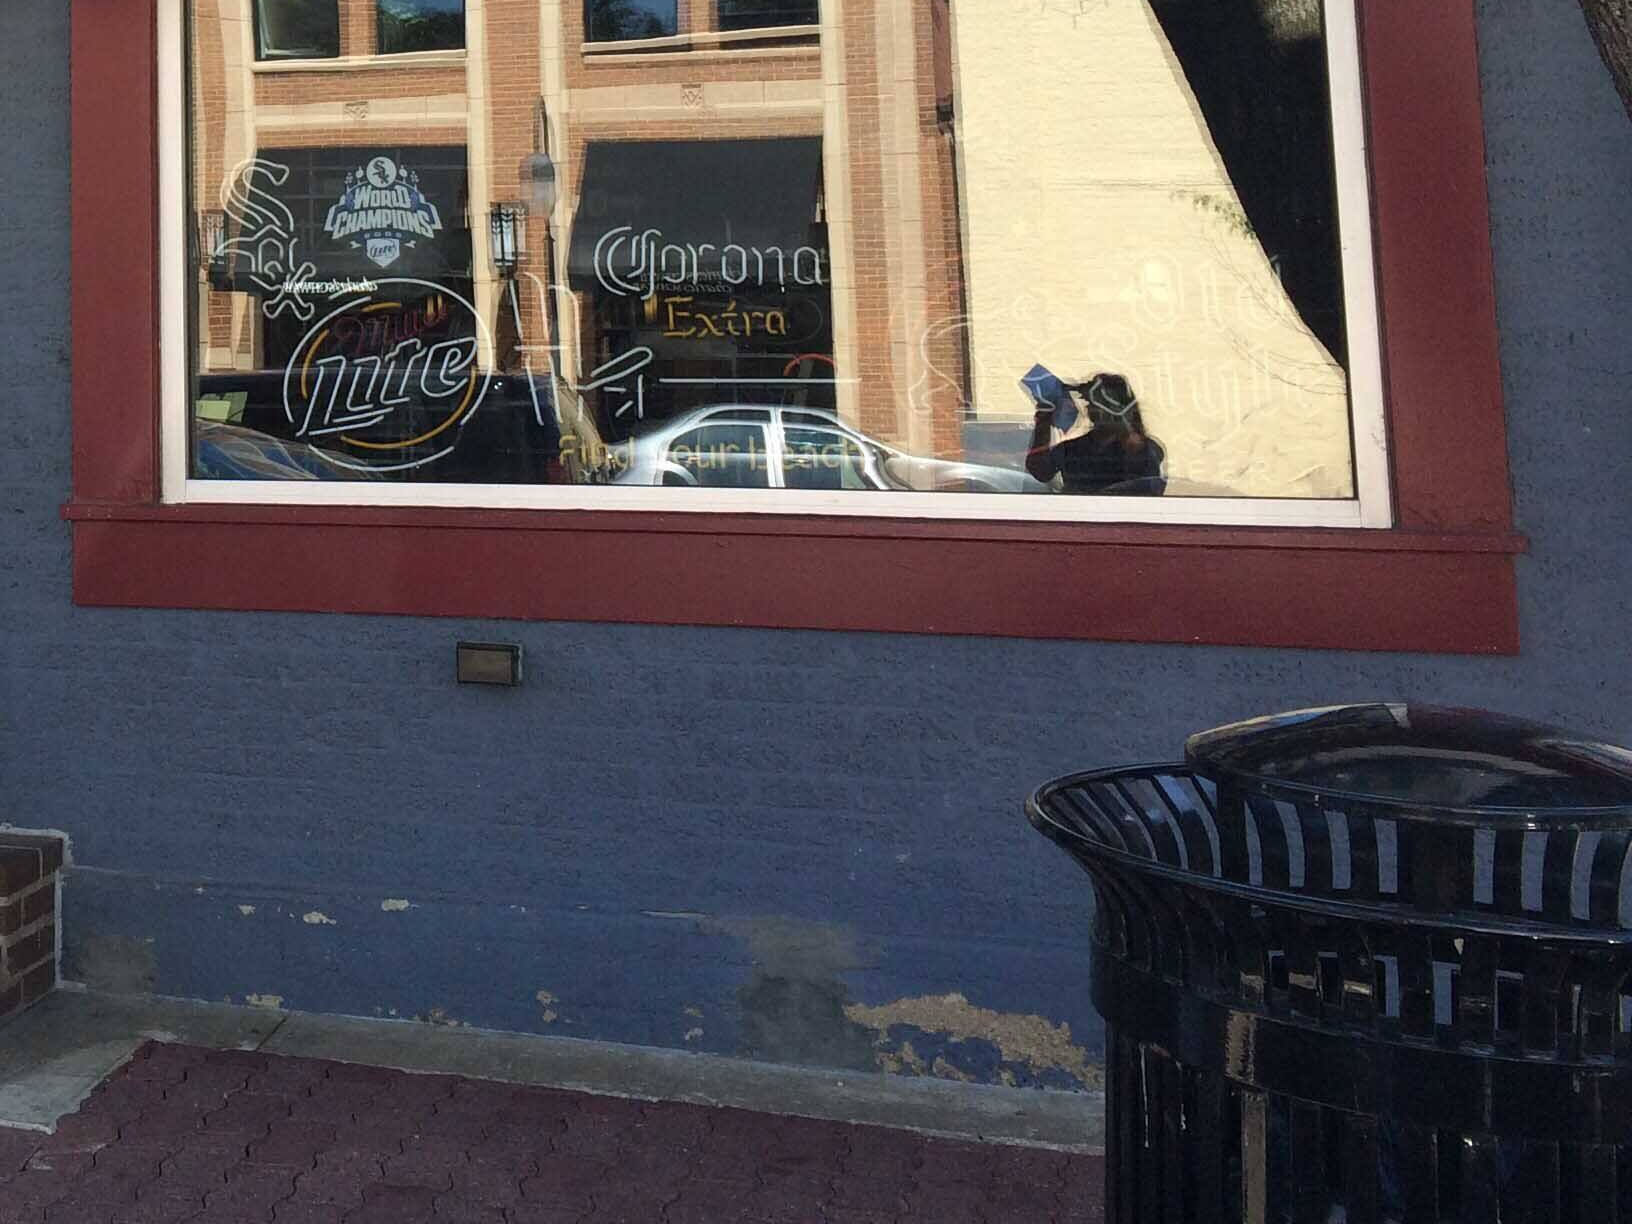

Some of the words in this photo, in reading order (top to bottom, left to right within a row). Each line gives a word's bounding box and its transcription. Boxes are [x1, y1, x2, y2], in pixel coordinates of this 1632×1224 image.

[353, 184, 412, 210] WORLD
[331, 208, 435, 240] CHAMPIONS
[594, 226, 824, 301] Corona
[663, 295, 787, 338] Extra
[296, 336, 480, 437] Lite
